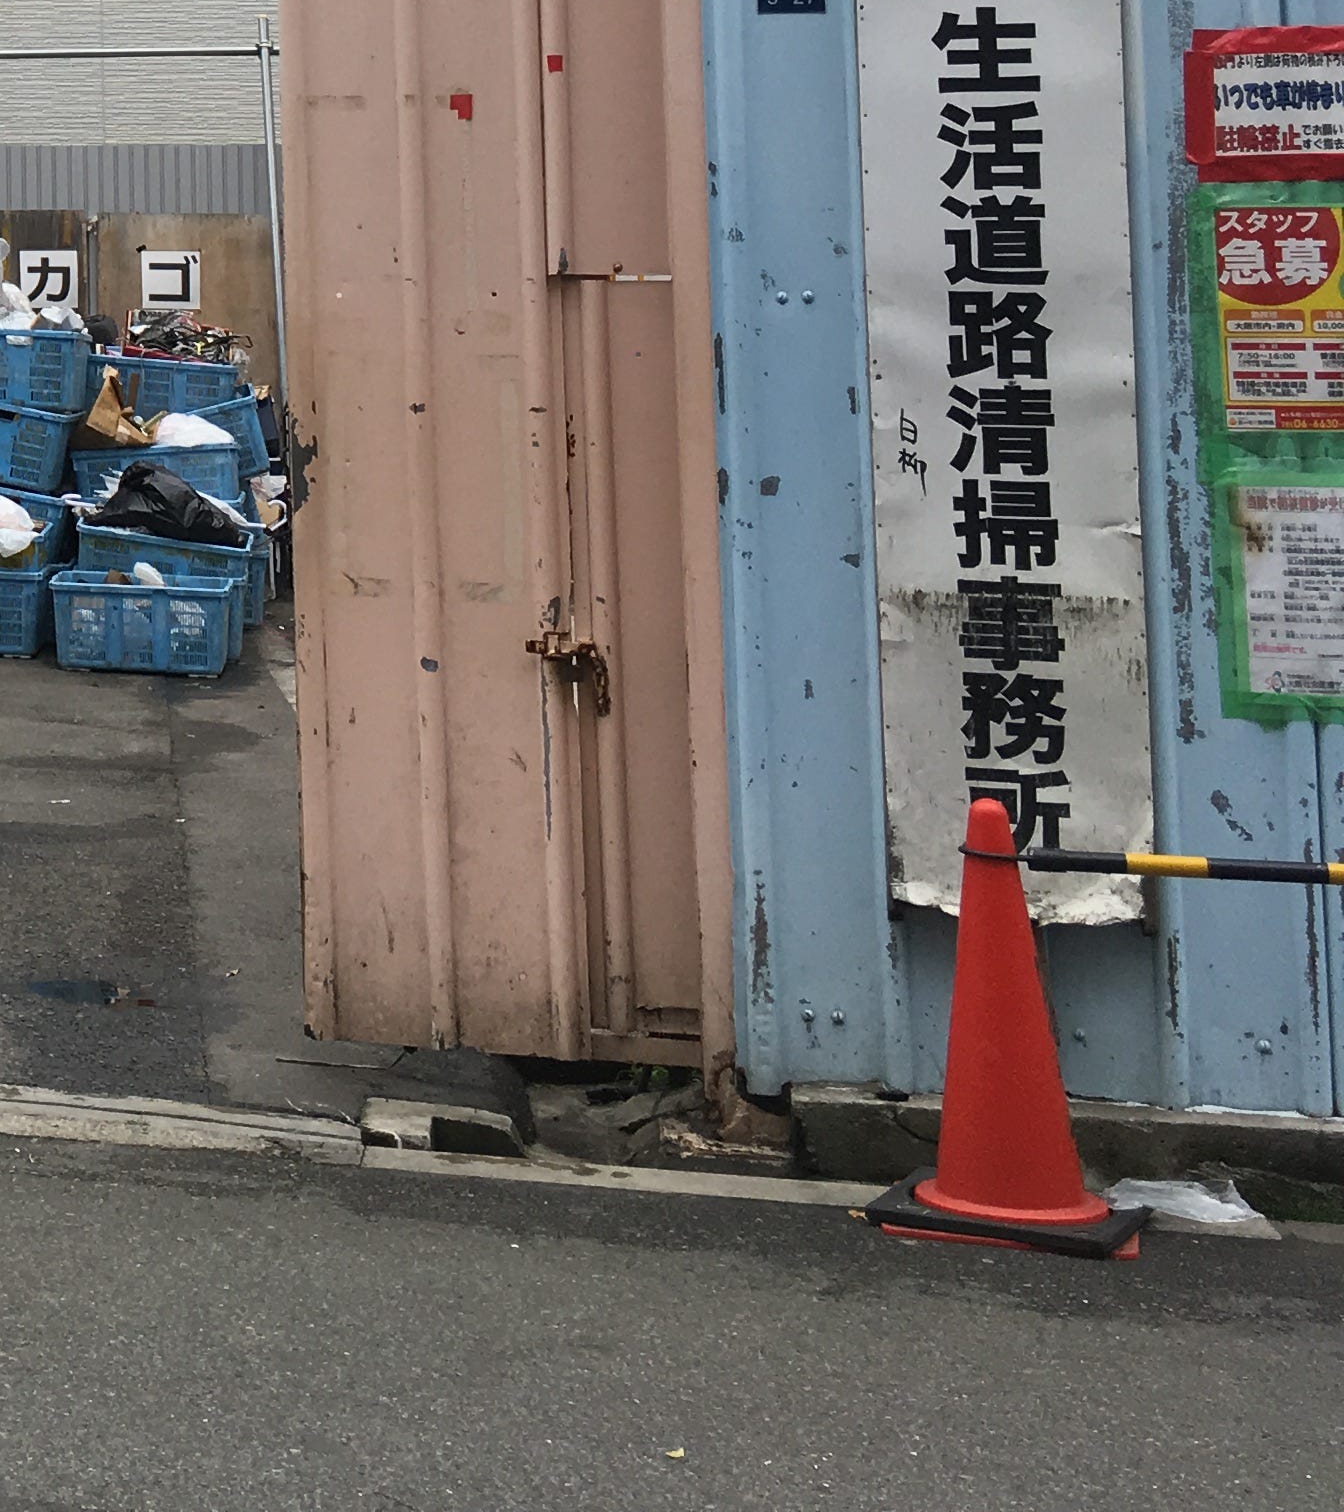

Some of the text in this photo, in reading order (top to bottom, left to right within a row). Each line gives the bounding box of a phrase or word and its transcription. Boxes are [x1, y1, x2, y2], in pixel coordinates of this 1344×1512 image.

[1218, 211, 1319, 233] スタッフ
[1218, 238, 1328, 286] 急募
[931, 7, 1071, 855] 生活道路清掃事務所
